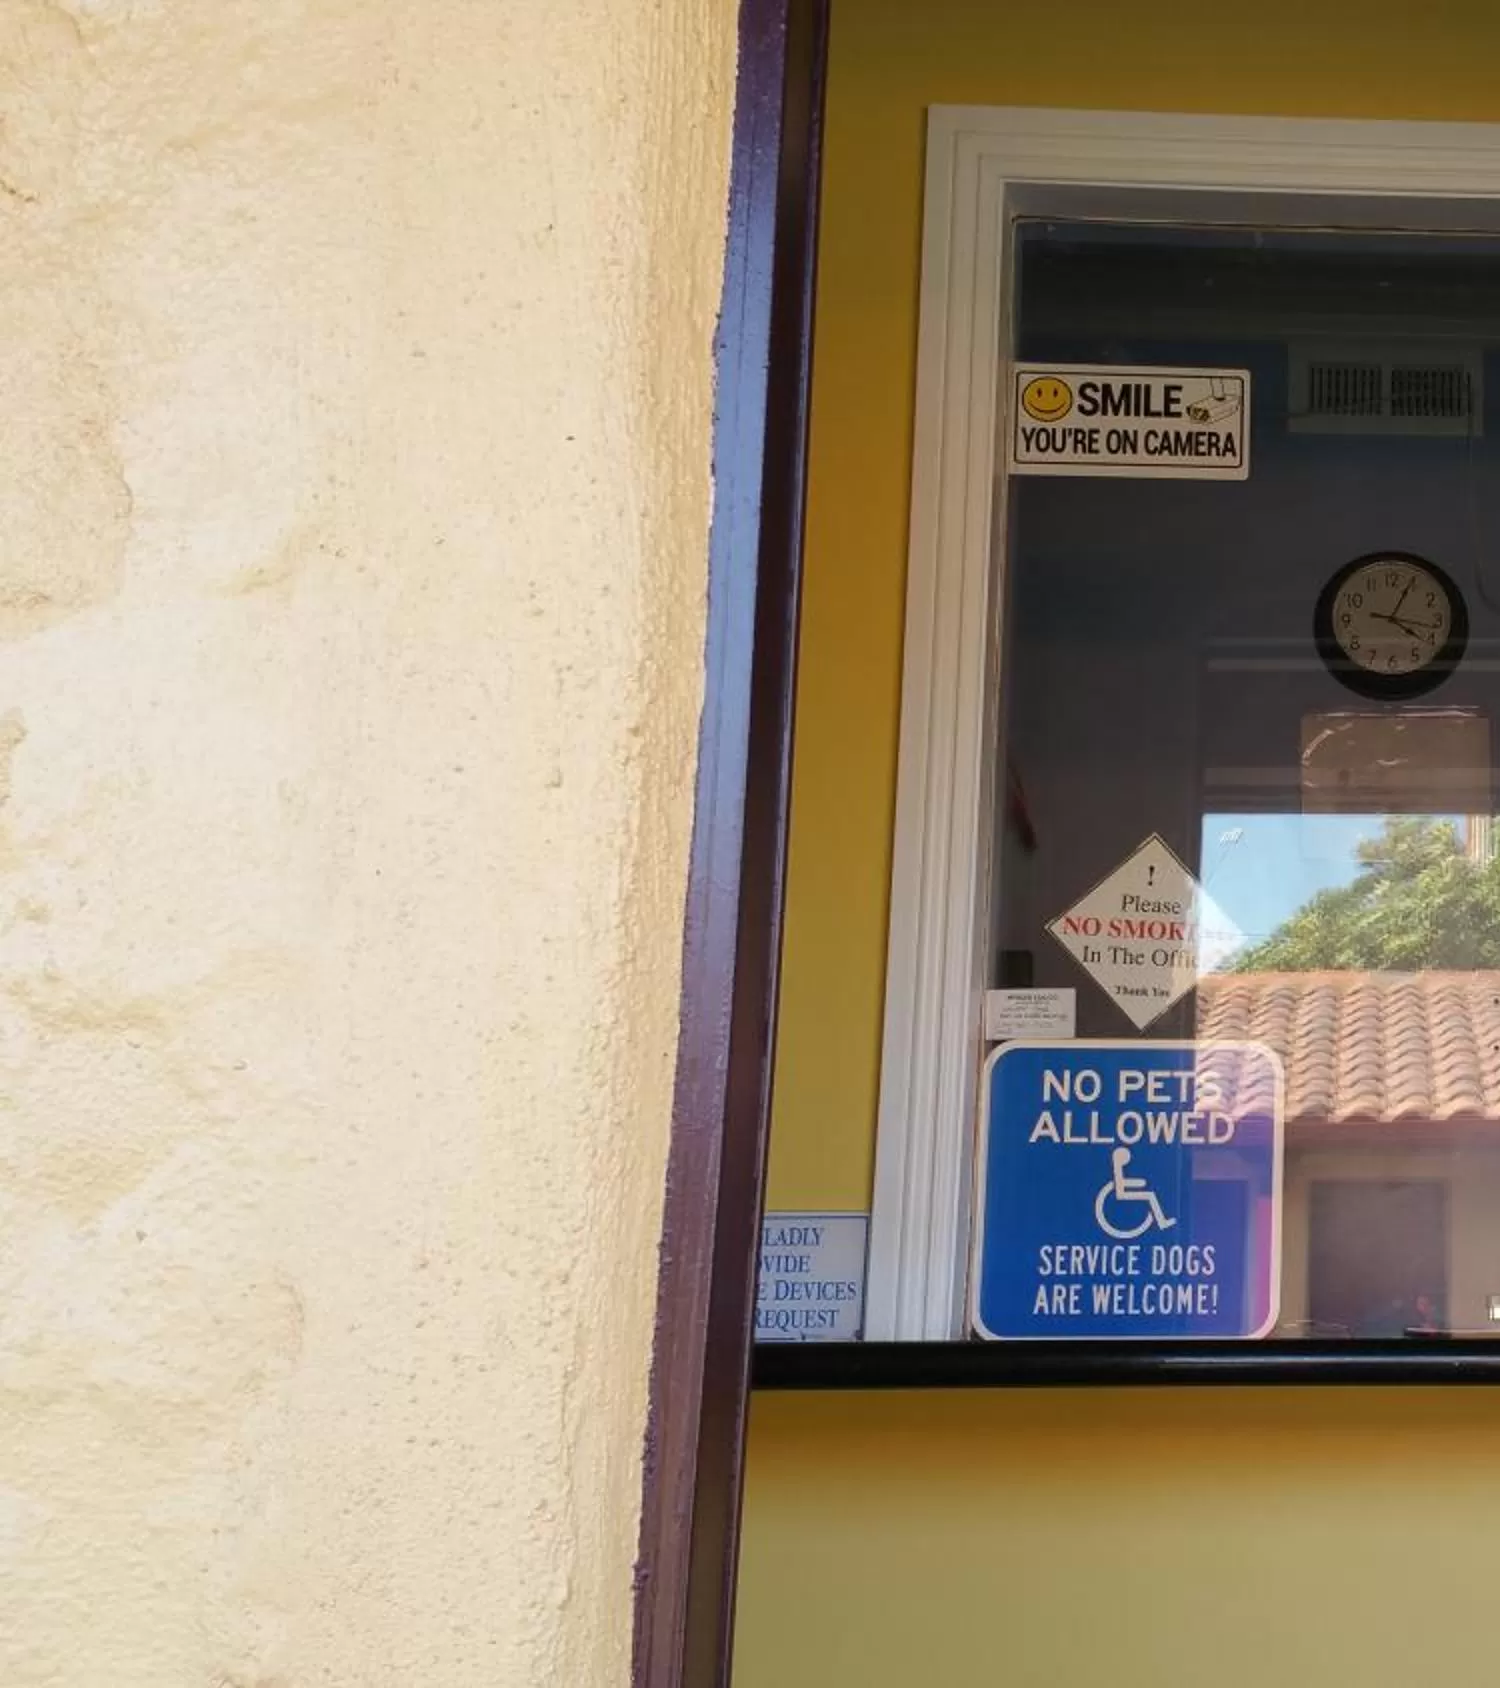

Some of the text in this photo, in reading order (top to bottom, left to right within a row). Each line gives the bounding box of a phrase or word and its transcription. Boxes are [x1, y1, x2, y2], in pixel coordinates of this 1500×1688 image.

[1077, 381, 1182, 418] SMILE
[1021, 427, 1237, 457] YOU'RE ON CAMERA
[1366, 577, 1377, 592] 11
[1384, 573, 1399, 588] 12
[1344, 593, 1363, 609] 10
[1426, 592, 1436, 608] 2
[1341, 613, 1351, 629] 9
[1367, 649, 1377, 665] 7
[1411, 647, 1420, 663] 5
[1120, 893, 1182, 916] Please
[1063, 916, 1199, 942] NO SMOK
[1082, 945, 1101, 964] In
[1109, 946, 1145, 966] The
[1043, 1069, 1223, 1104] NO PETS
[1029, 1111, 1235, 1145] ALLOWED
[763, 1227, 825, 1246] LADLY
[763, 1255, 811, 1273] VIDE
[1039, 1245, 1216, 1276] SERVICE DOGS
[775, 1279, 857, 1301] DEVICES
[1033, 1284, 1219, 1316] ARE WELCOME!
